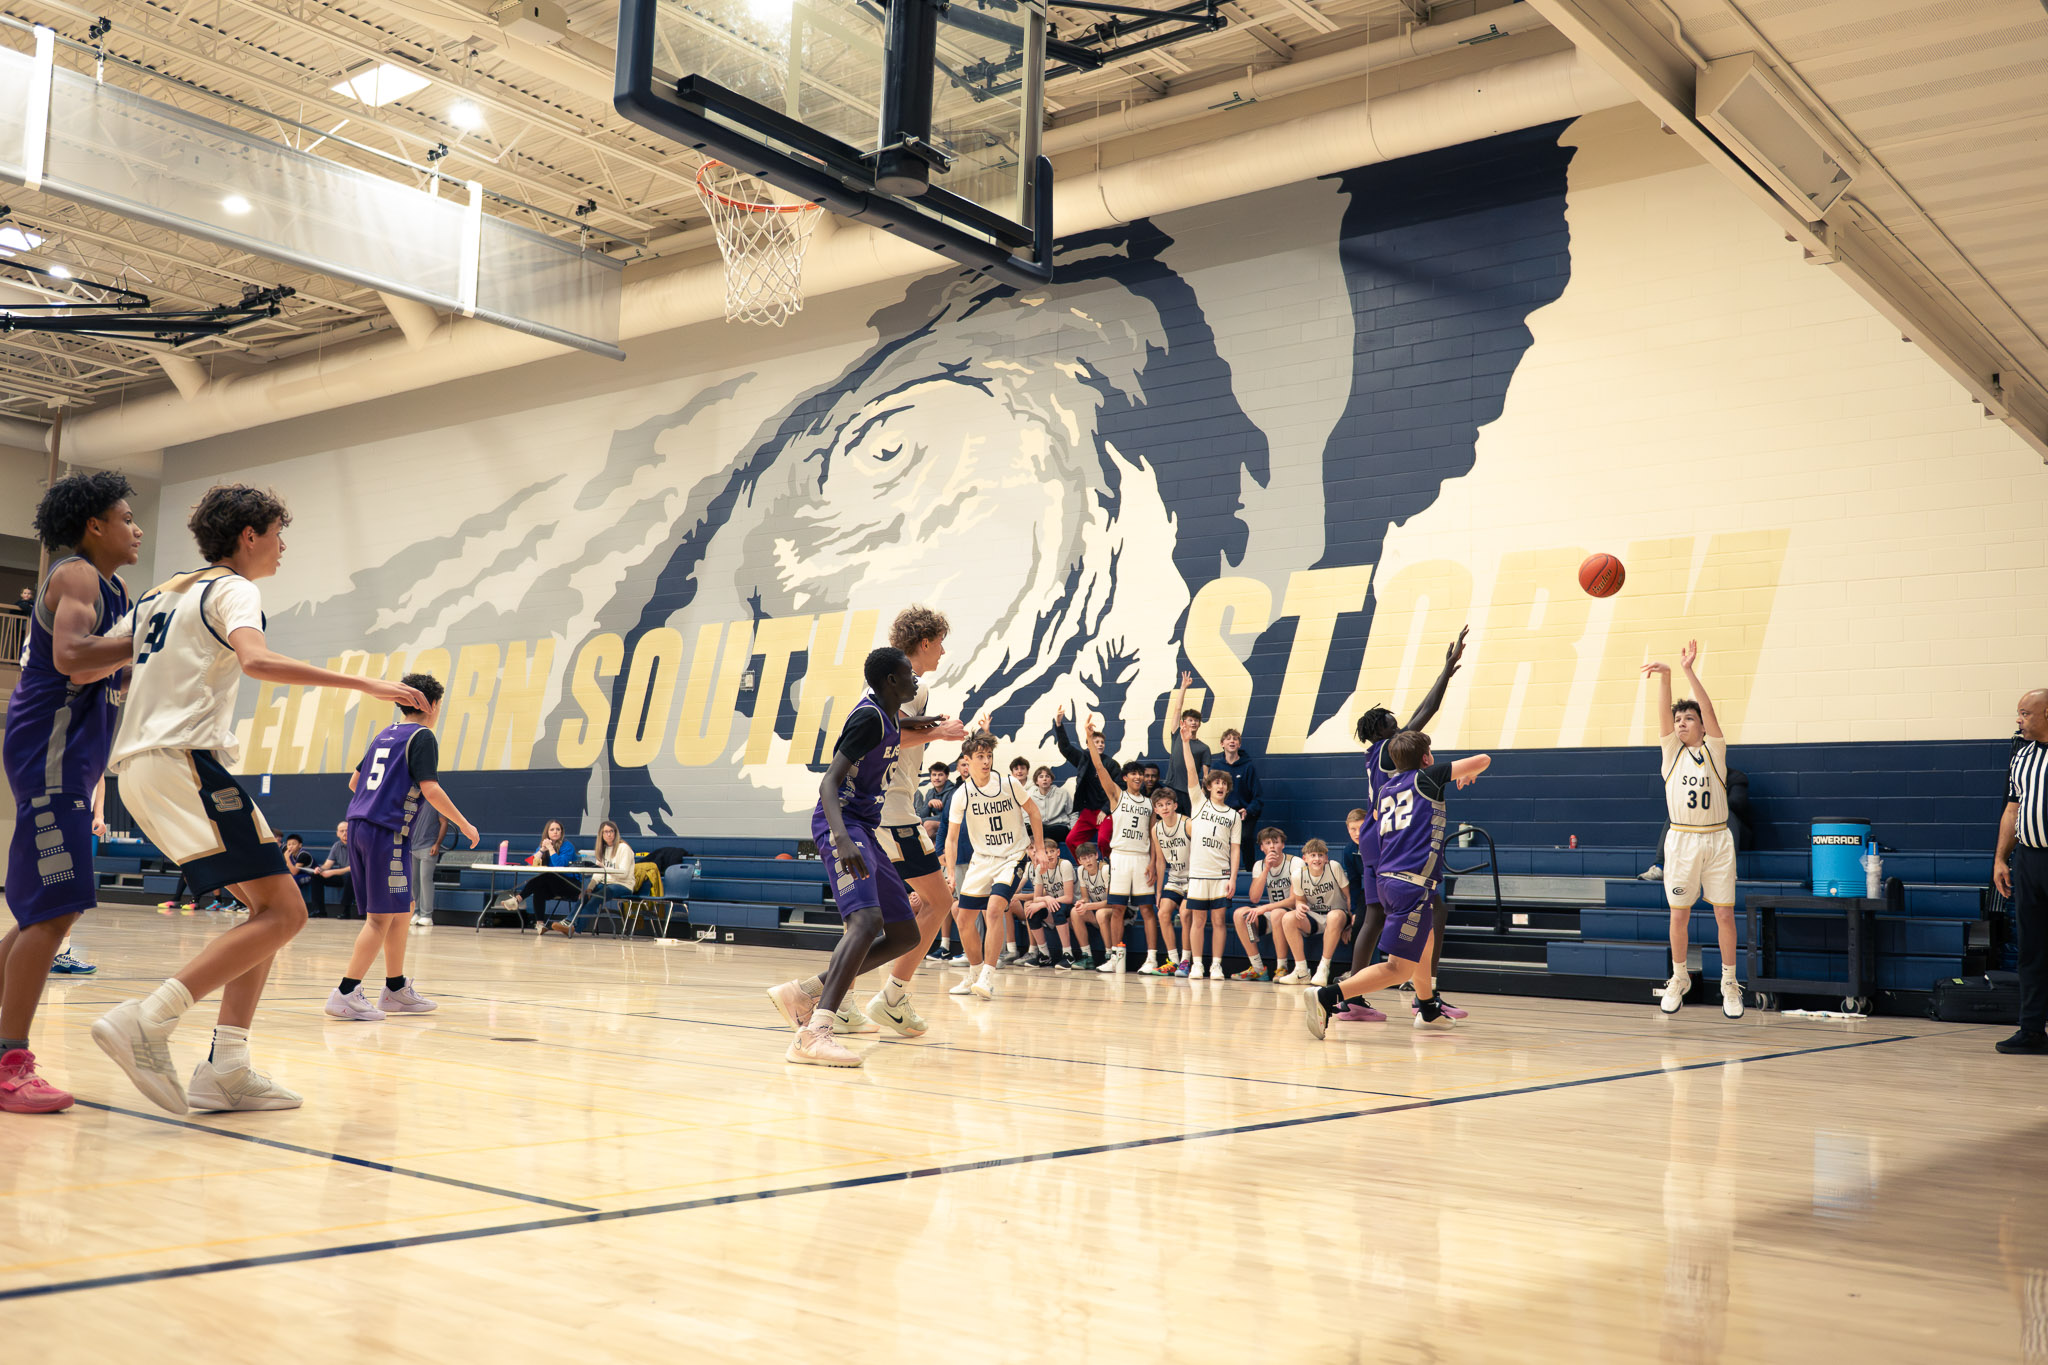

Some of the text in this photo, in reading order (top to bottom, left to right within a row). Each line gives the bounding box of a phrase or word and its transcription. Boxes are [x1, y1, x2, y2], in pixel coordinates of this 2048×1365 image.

[243, 528, 1792, 775] ELKHORN SOUTH STORM
[366, 747, 391, 791] 5
[972, 798, 1014, 815] ELKHORN
[1687, 790, 1711, 810] 30
[1121, 803, 1152, 817] ELKHORN
[1380, 789, 1414, 836] 22
[989, 816, 1003, 831] 10
[1131, 816, 1139, 828] 3
[1201, 811, 1233, 828] ELKHORN
[1122, 829, 1143, 840] SOUTH
[1212, 826, 1217, 836] 1
[985, 832, 1013, 845] SOUTH
[1159, 838, 1187, 848] ELKHORN
[1813, 835, 1860, 845] POWERADE
[1170, 862, 1185, 871] OUTH
[1267, 877, 1291, 889] KHORN
[1304, 881, 1334, 896] ELKHORN
[1271, 890, 1285, 902] 23
